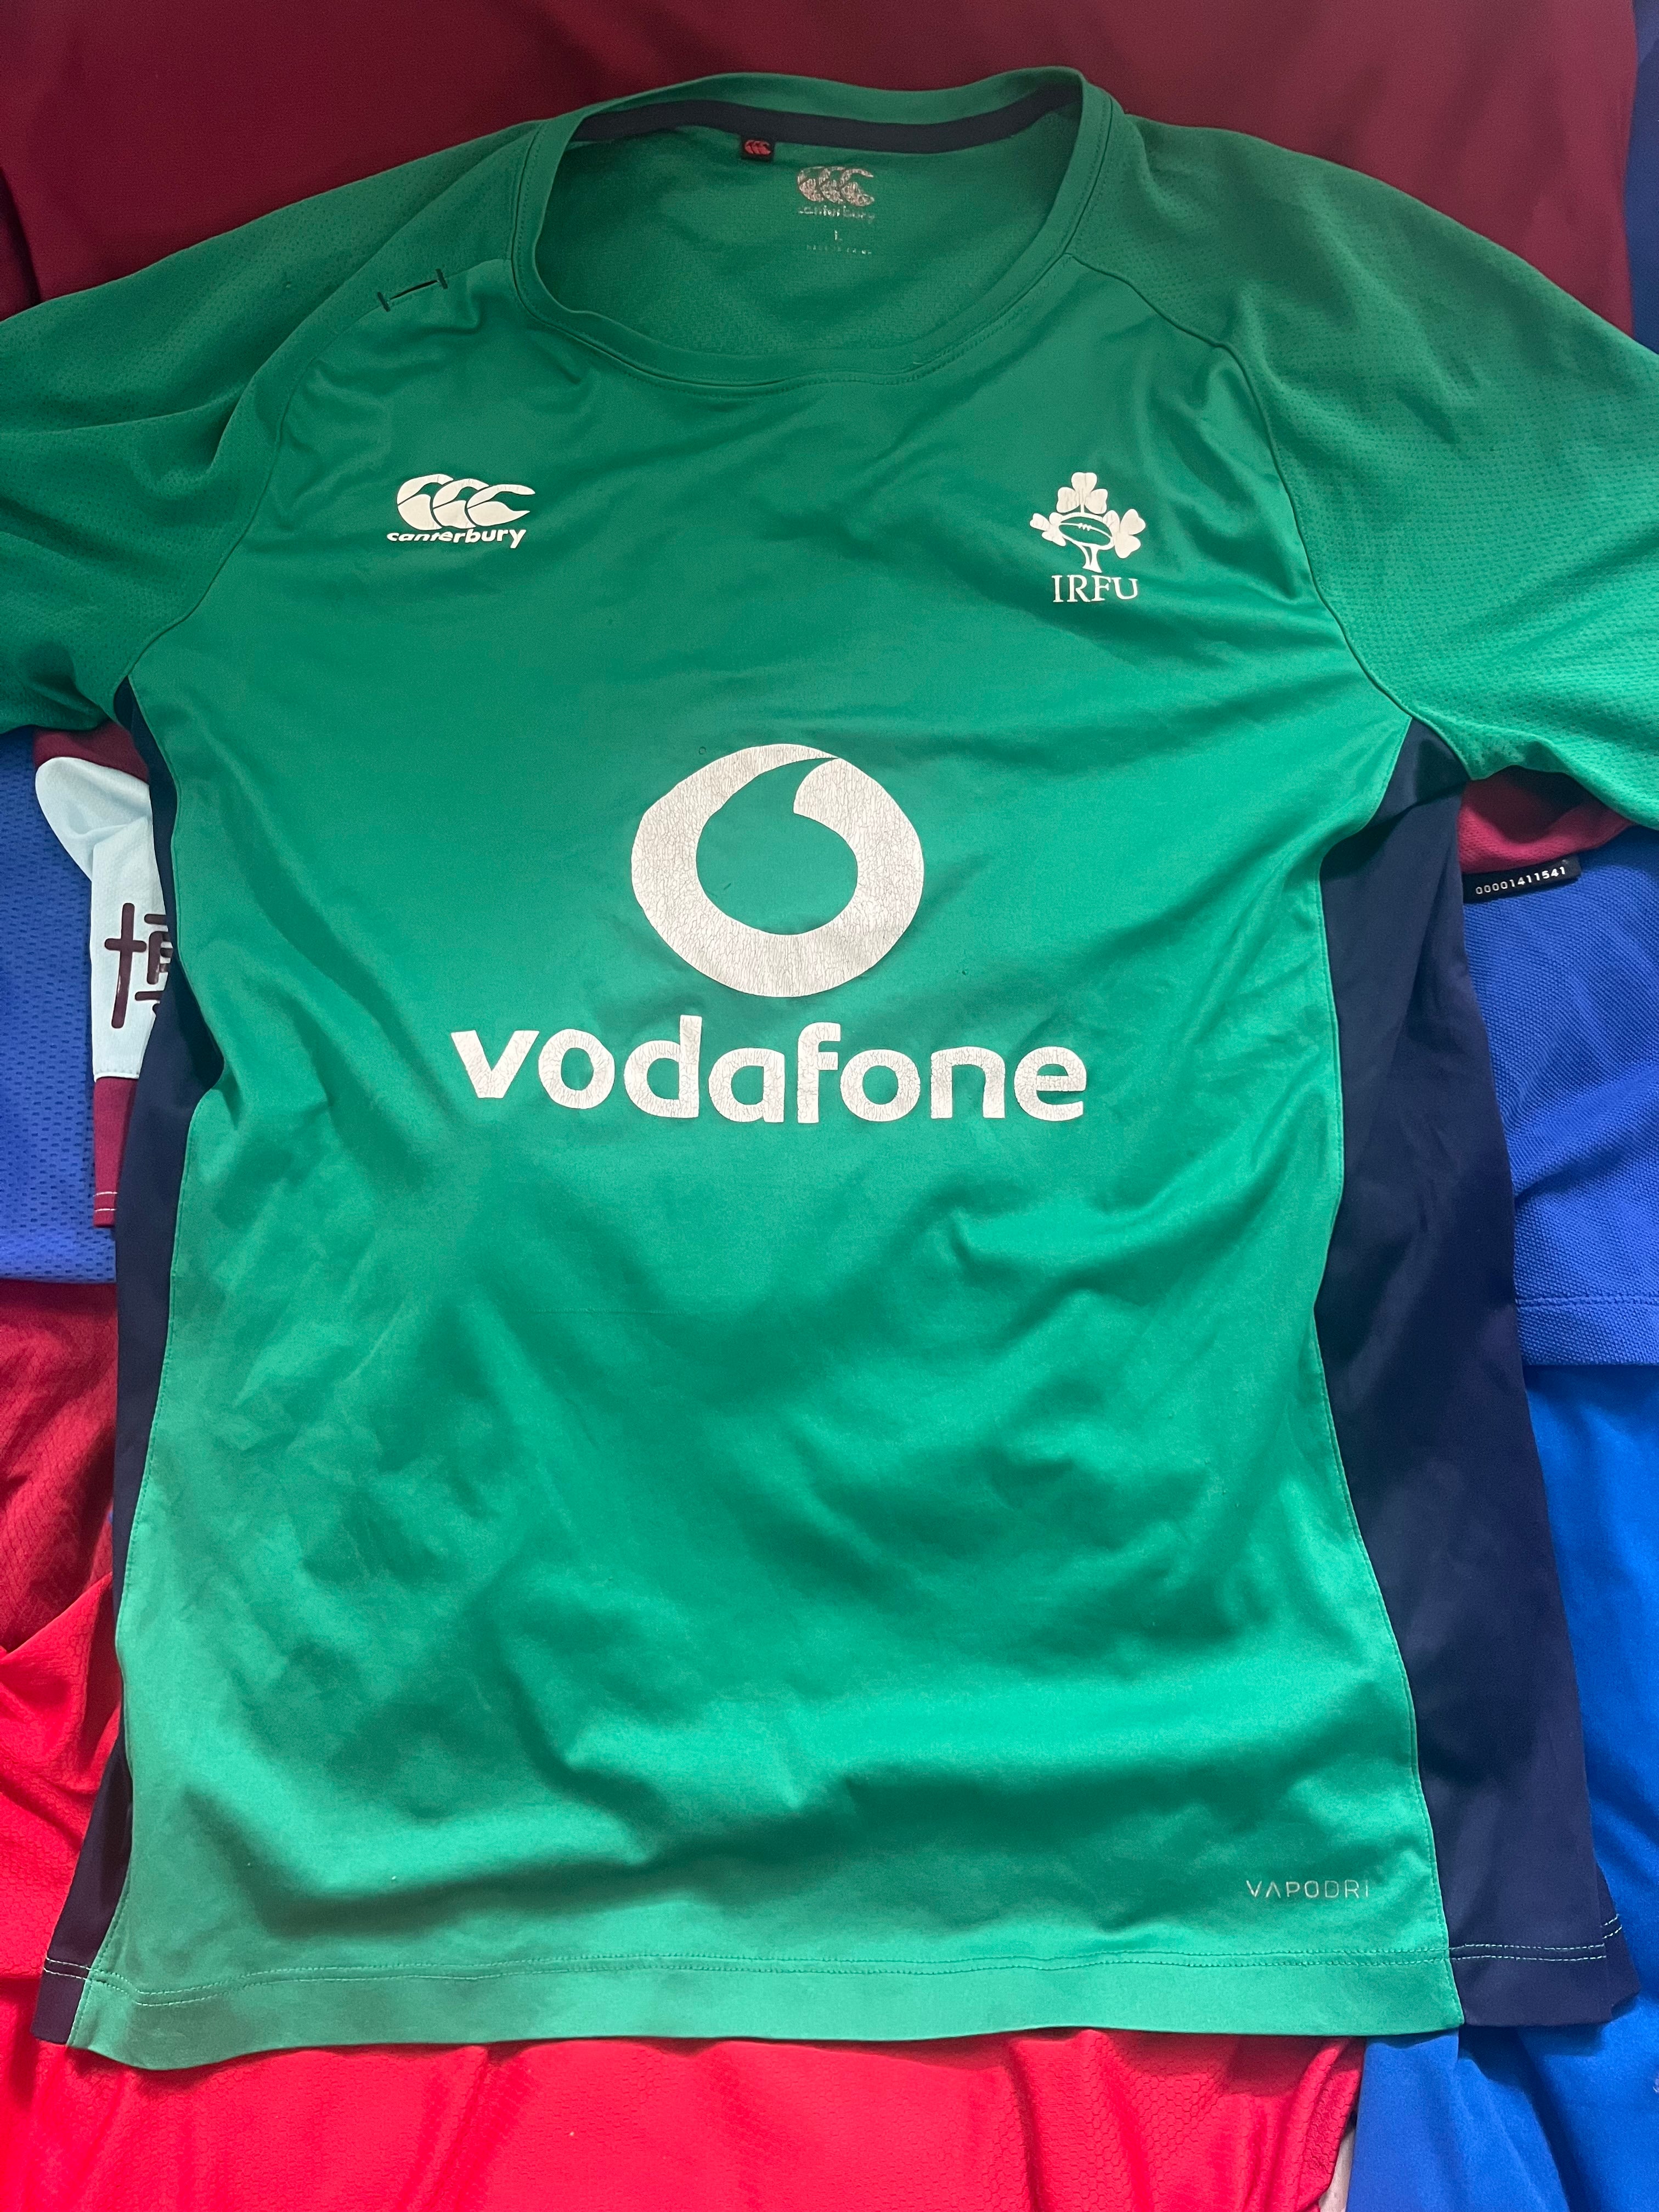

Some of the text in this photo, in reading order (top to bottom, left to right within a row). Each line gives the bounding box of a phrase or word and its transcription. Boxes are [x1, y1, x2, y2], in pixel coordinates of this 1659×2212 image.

[387, 528, 527, 549] canterbury
[1051, 574, 1138, 603] IRFU
[1475, 866, 1566, 894] 00001411541
[450, 1014, 1088, 1124] vodafone
[1245, 1879, 1369, 1898] VAPODRI
